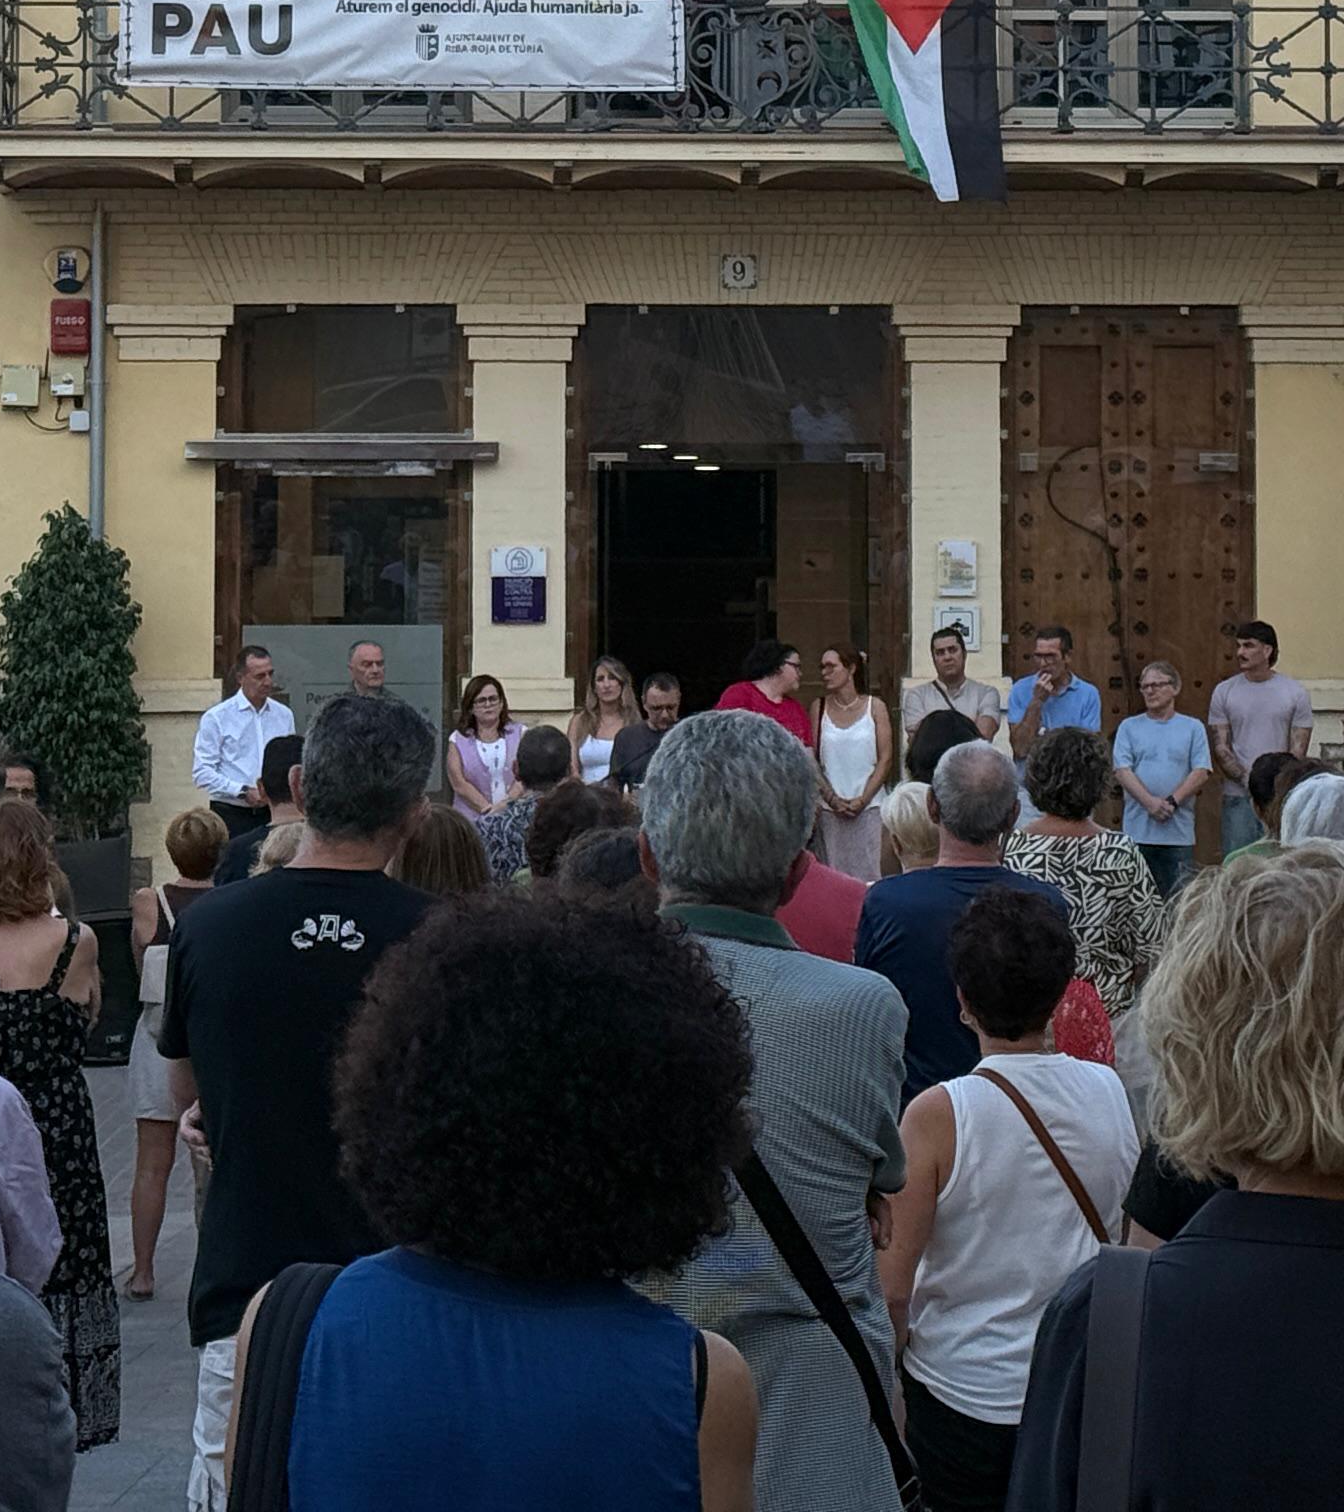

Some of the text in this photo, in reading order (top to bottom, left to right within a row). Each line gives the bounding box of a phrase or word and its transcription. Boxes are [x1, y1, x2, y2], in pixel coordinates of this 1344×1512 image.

[335, 0, 644, 18] Aturem el genocidi. Ajuda humanitària ja.
[151, 3, 293, 56] PAU
[444, 34, 526, 43] AJUNTAMENT DE
[732, 260, 746, 282] 9
[54, 316, 86, 326] FUEGO
